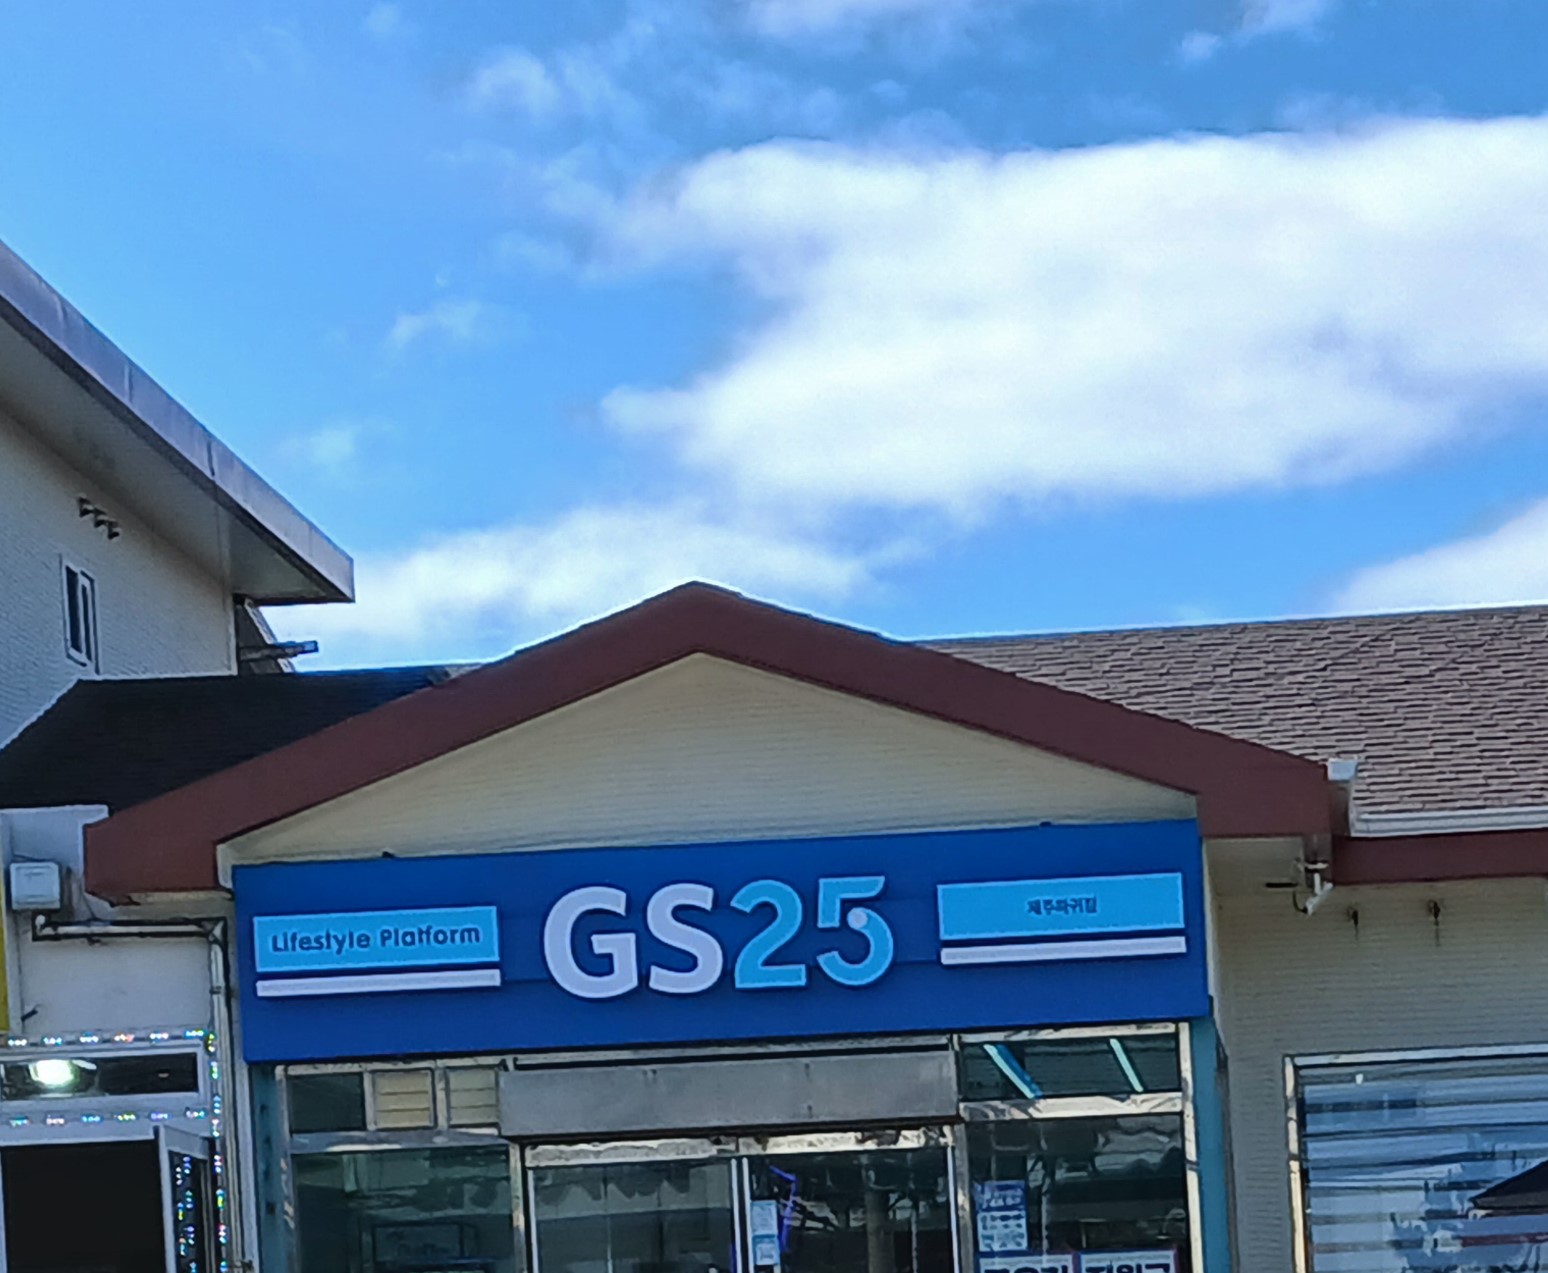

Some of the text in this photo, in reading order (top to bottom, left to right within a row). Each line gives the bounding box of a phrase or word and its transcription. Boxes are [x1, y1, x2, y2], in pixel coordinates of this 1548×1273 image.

[271, 925, 481, 955] Lifestyle Platform
[543, 875, 895, 999] GS25
